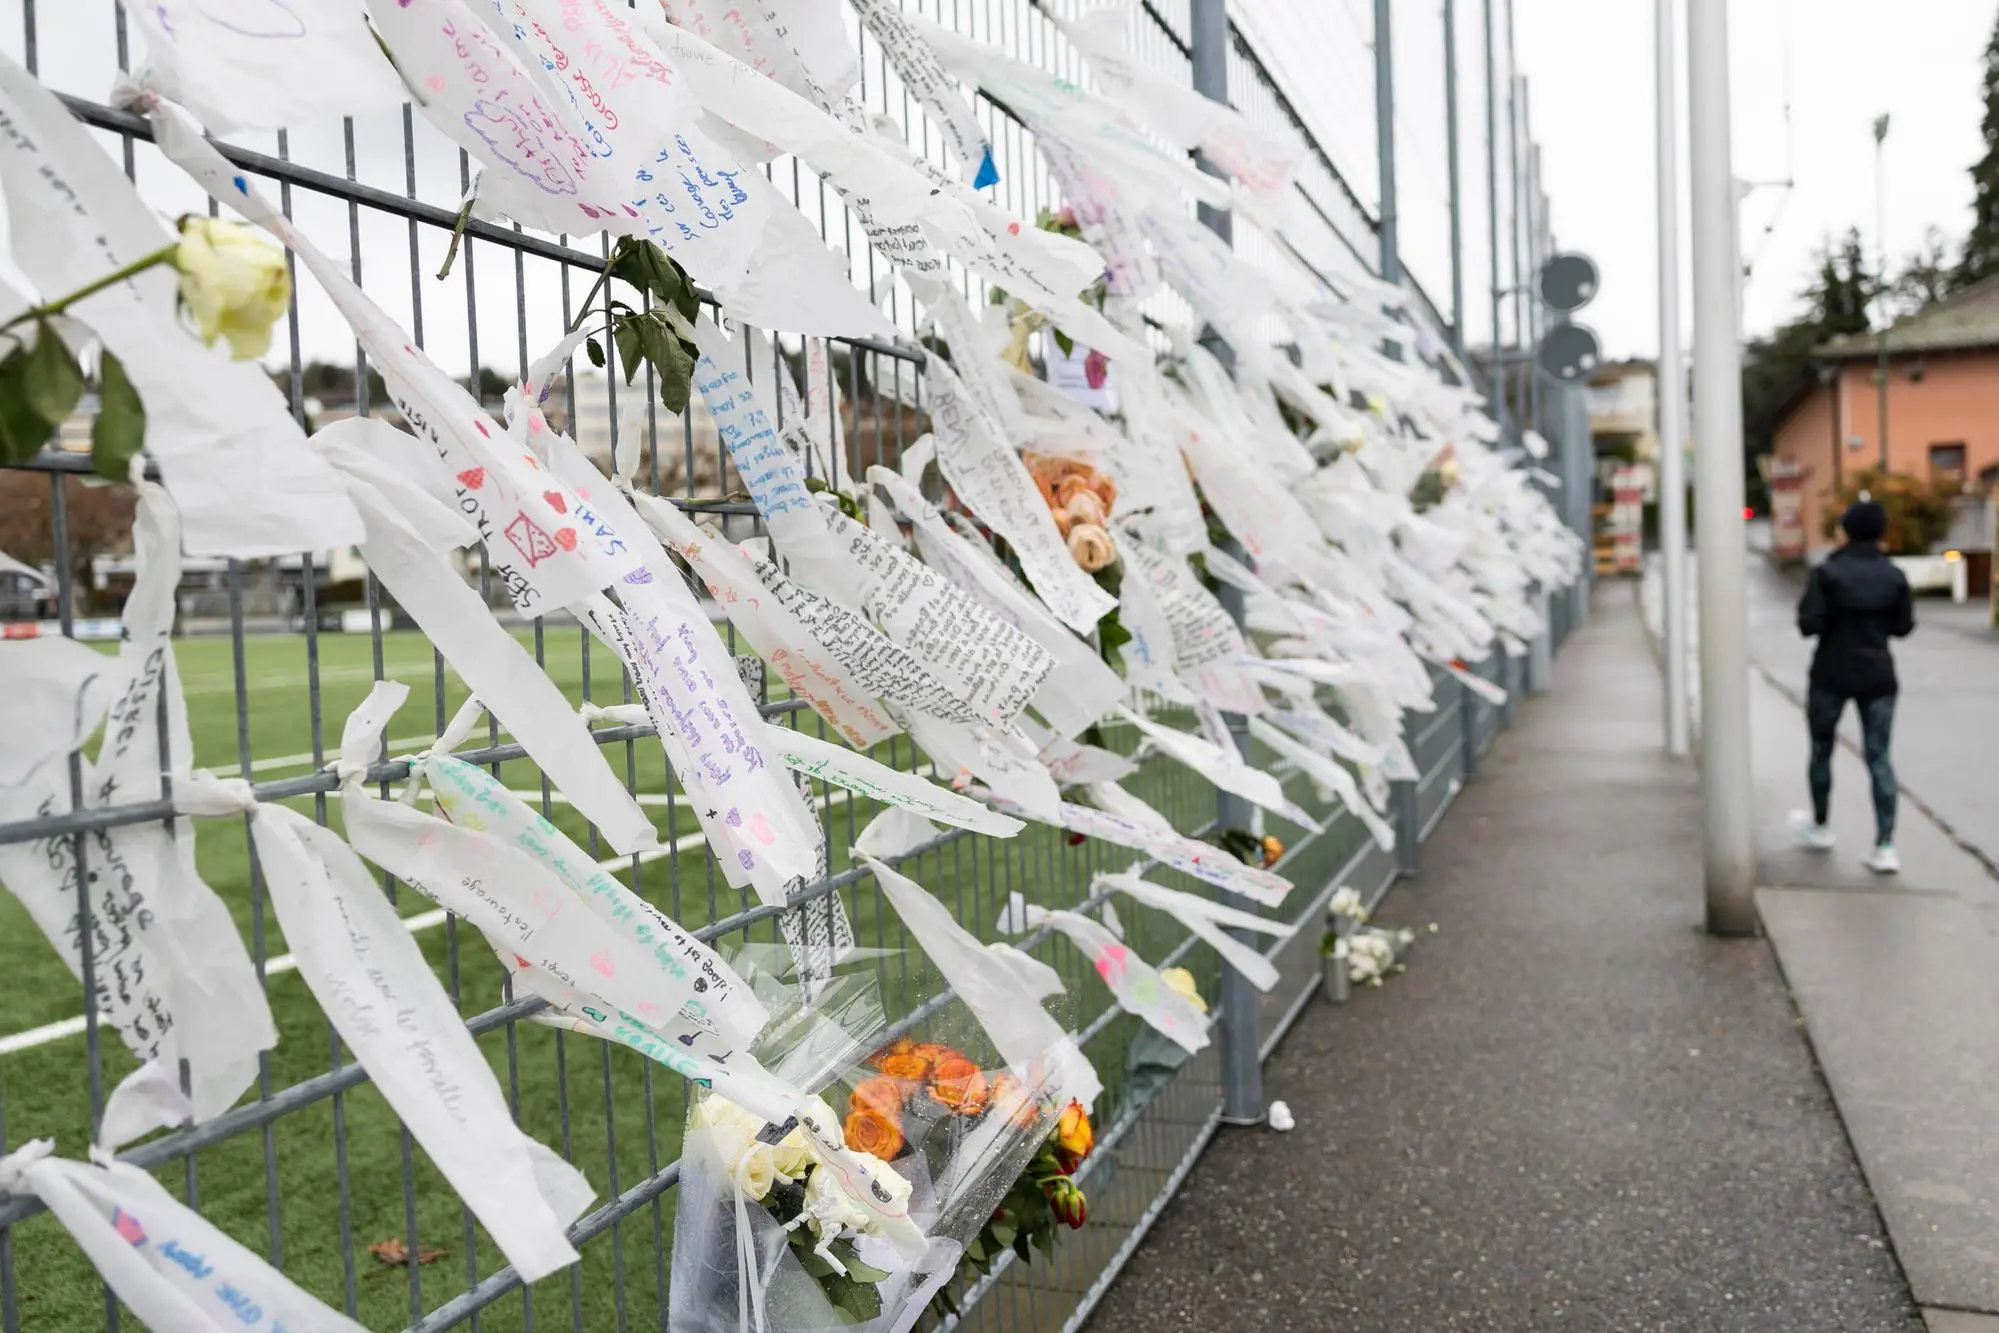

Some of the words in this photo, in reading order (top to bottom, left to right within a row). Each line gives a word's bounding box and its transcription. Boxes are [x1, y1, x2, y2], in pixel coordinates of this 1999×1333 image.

[86, 823, 151, 930] ourage
[461, 876, 534, 942] l'entourage
[539, 959, 576, 992] temps
